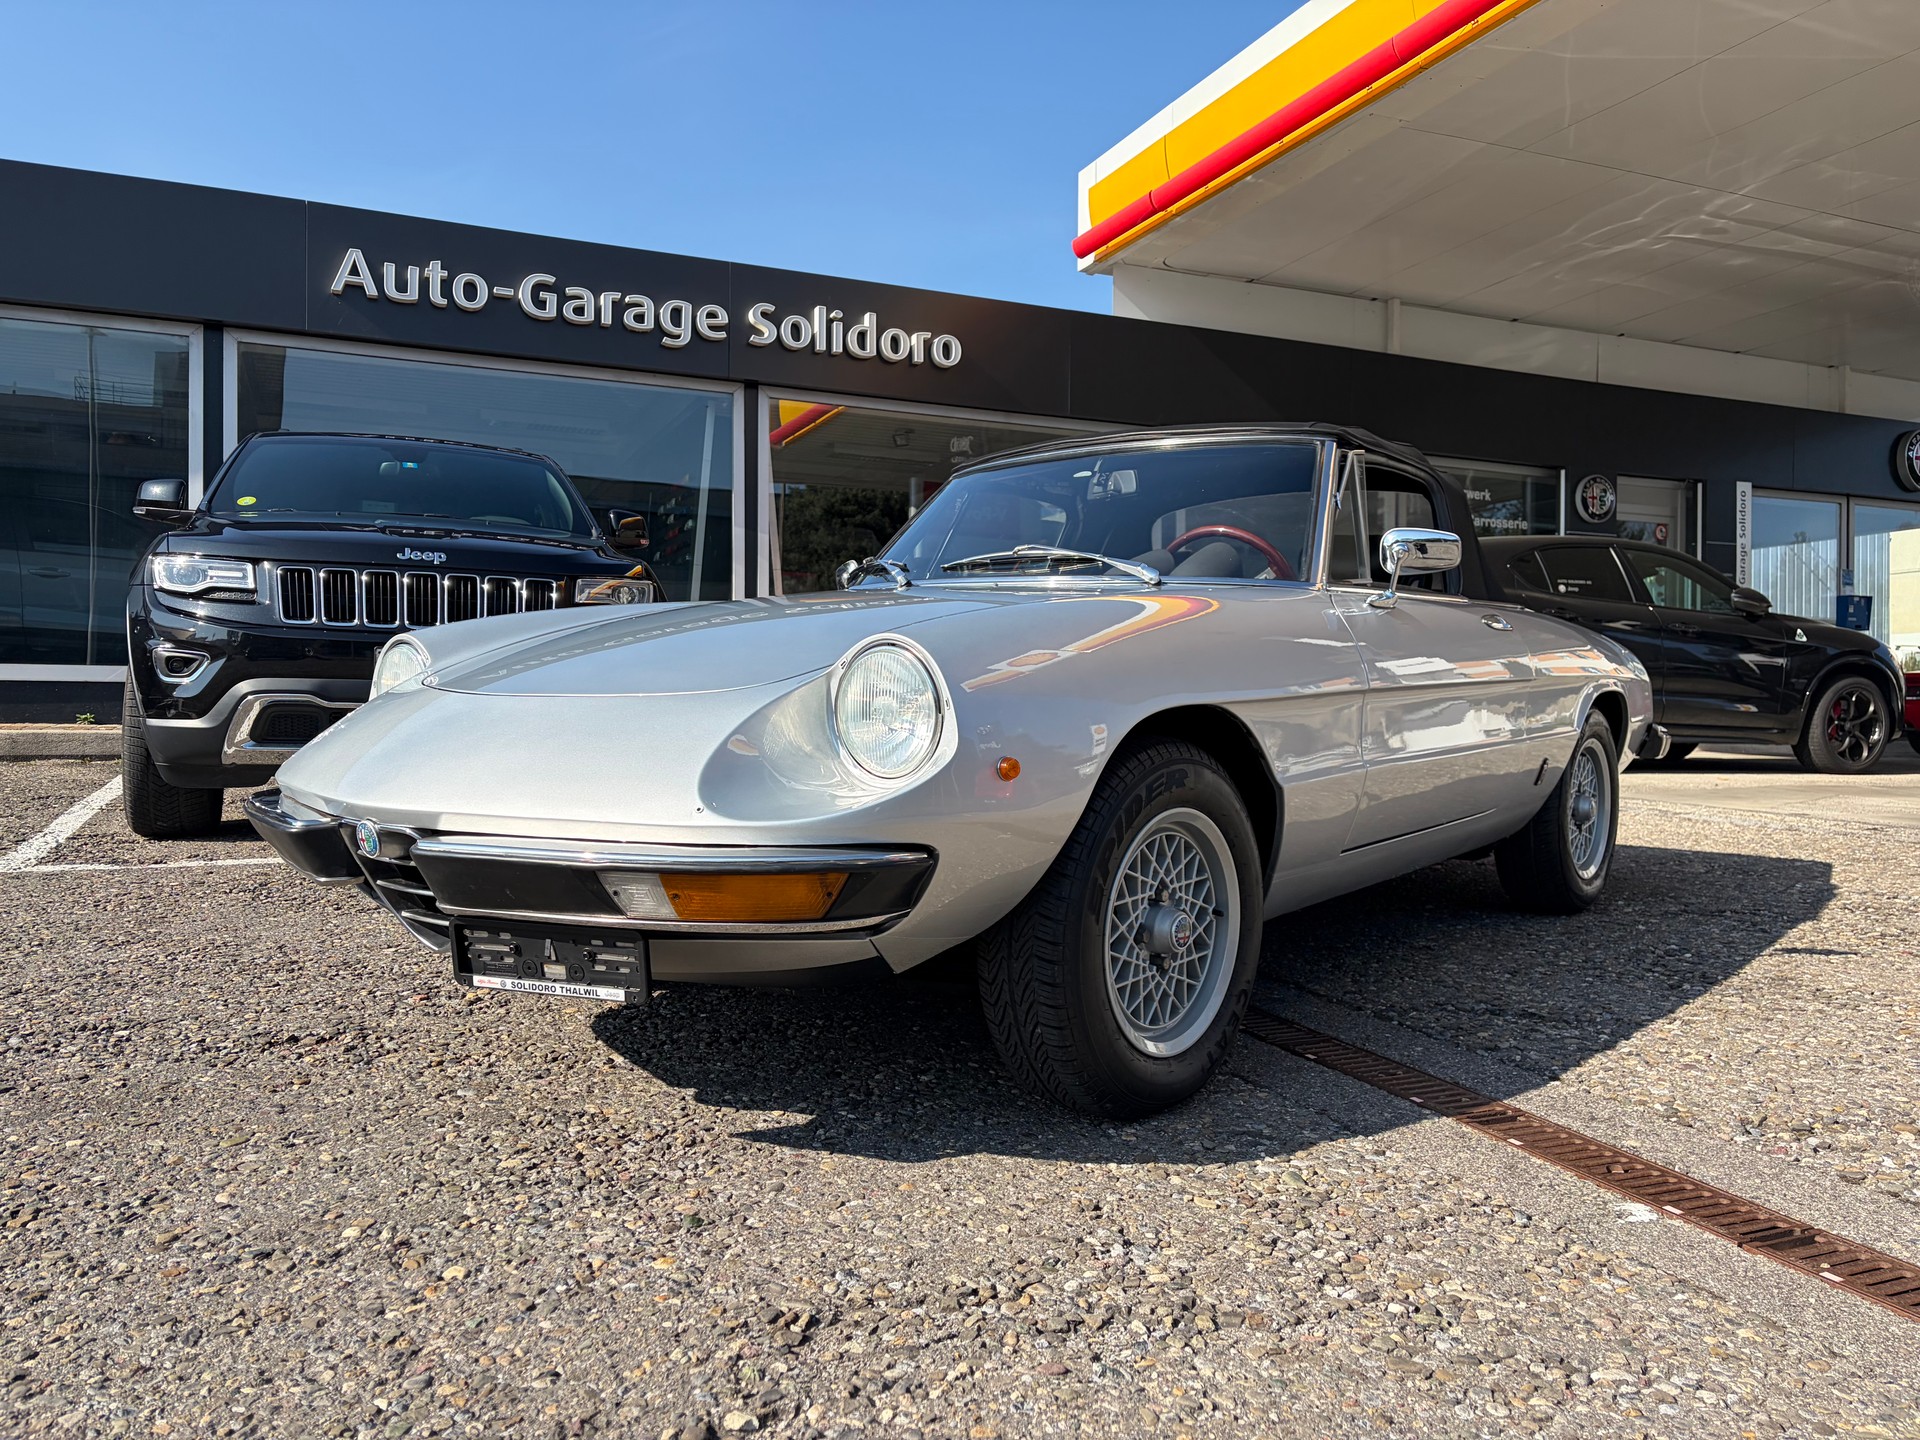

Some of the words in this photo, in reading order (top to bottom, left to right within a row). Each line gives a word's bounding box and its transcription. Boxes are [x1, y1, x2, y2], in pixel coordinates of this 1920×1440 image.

[331, 247, 728, 348] Auto-Garage
[747, 302, 962, 369] Solidoro
[1471, 516, 1528, 530] arrosserie
[1739, 490, 1747, 539] Solidoro
[396, 547, 447, 565] Jeep
[1739, 543, 1748, 585] Garage
[511, 980, 557, 993] SOLIDORO
[559, 985, 601, 997] THALWIL
